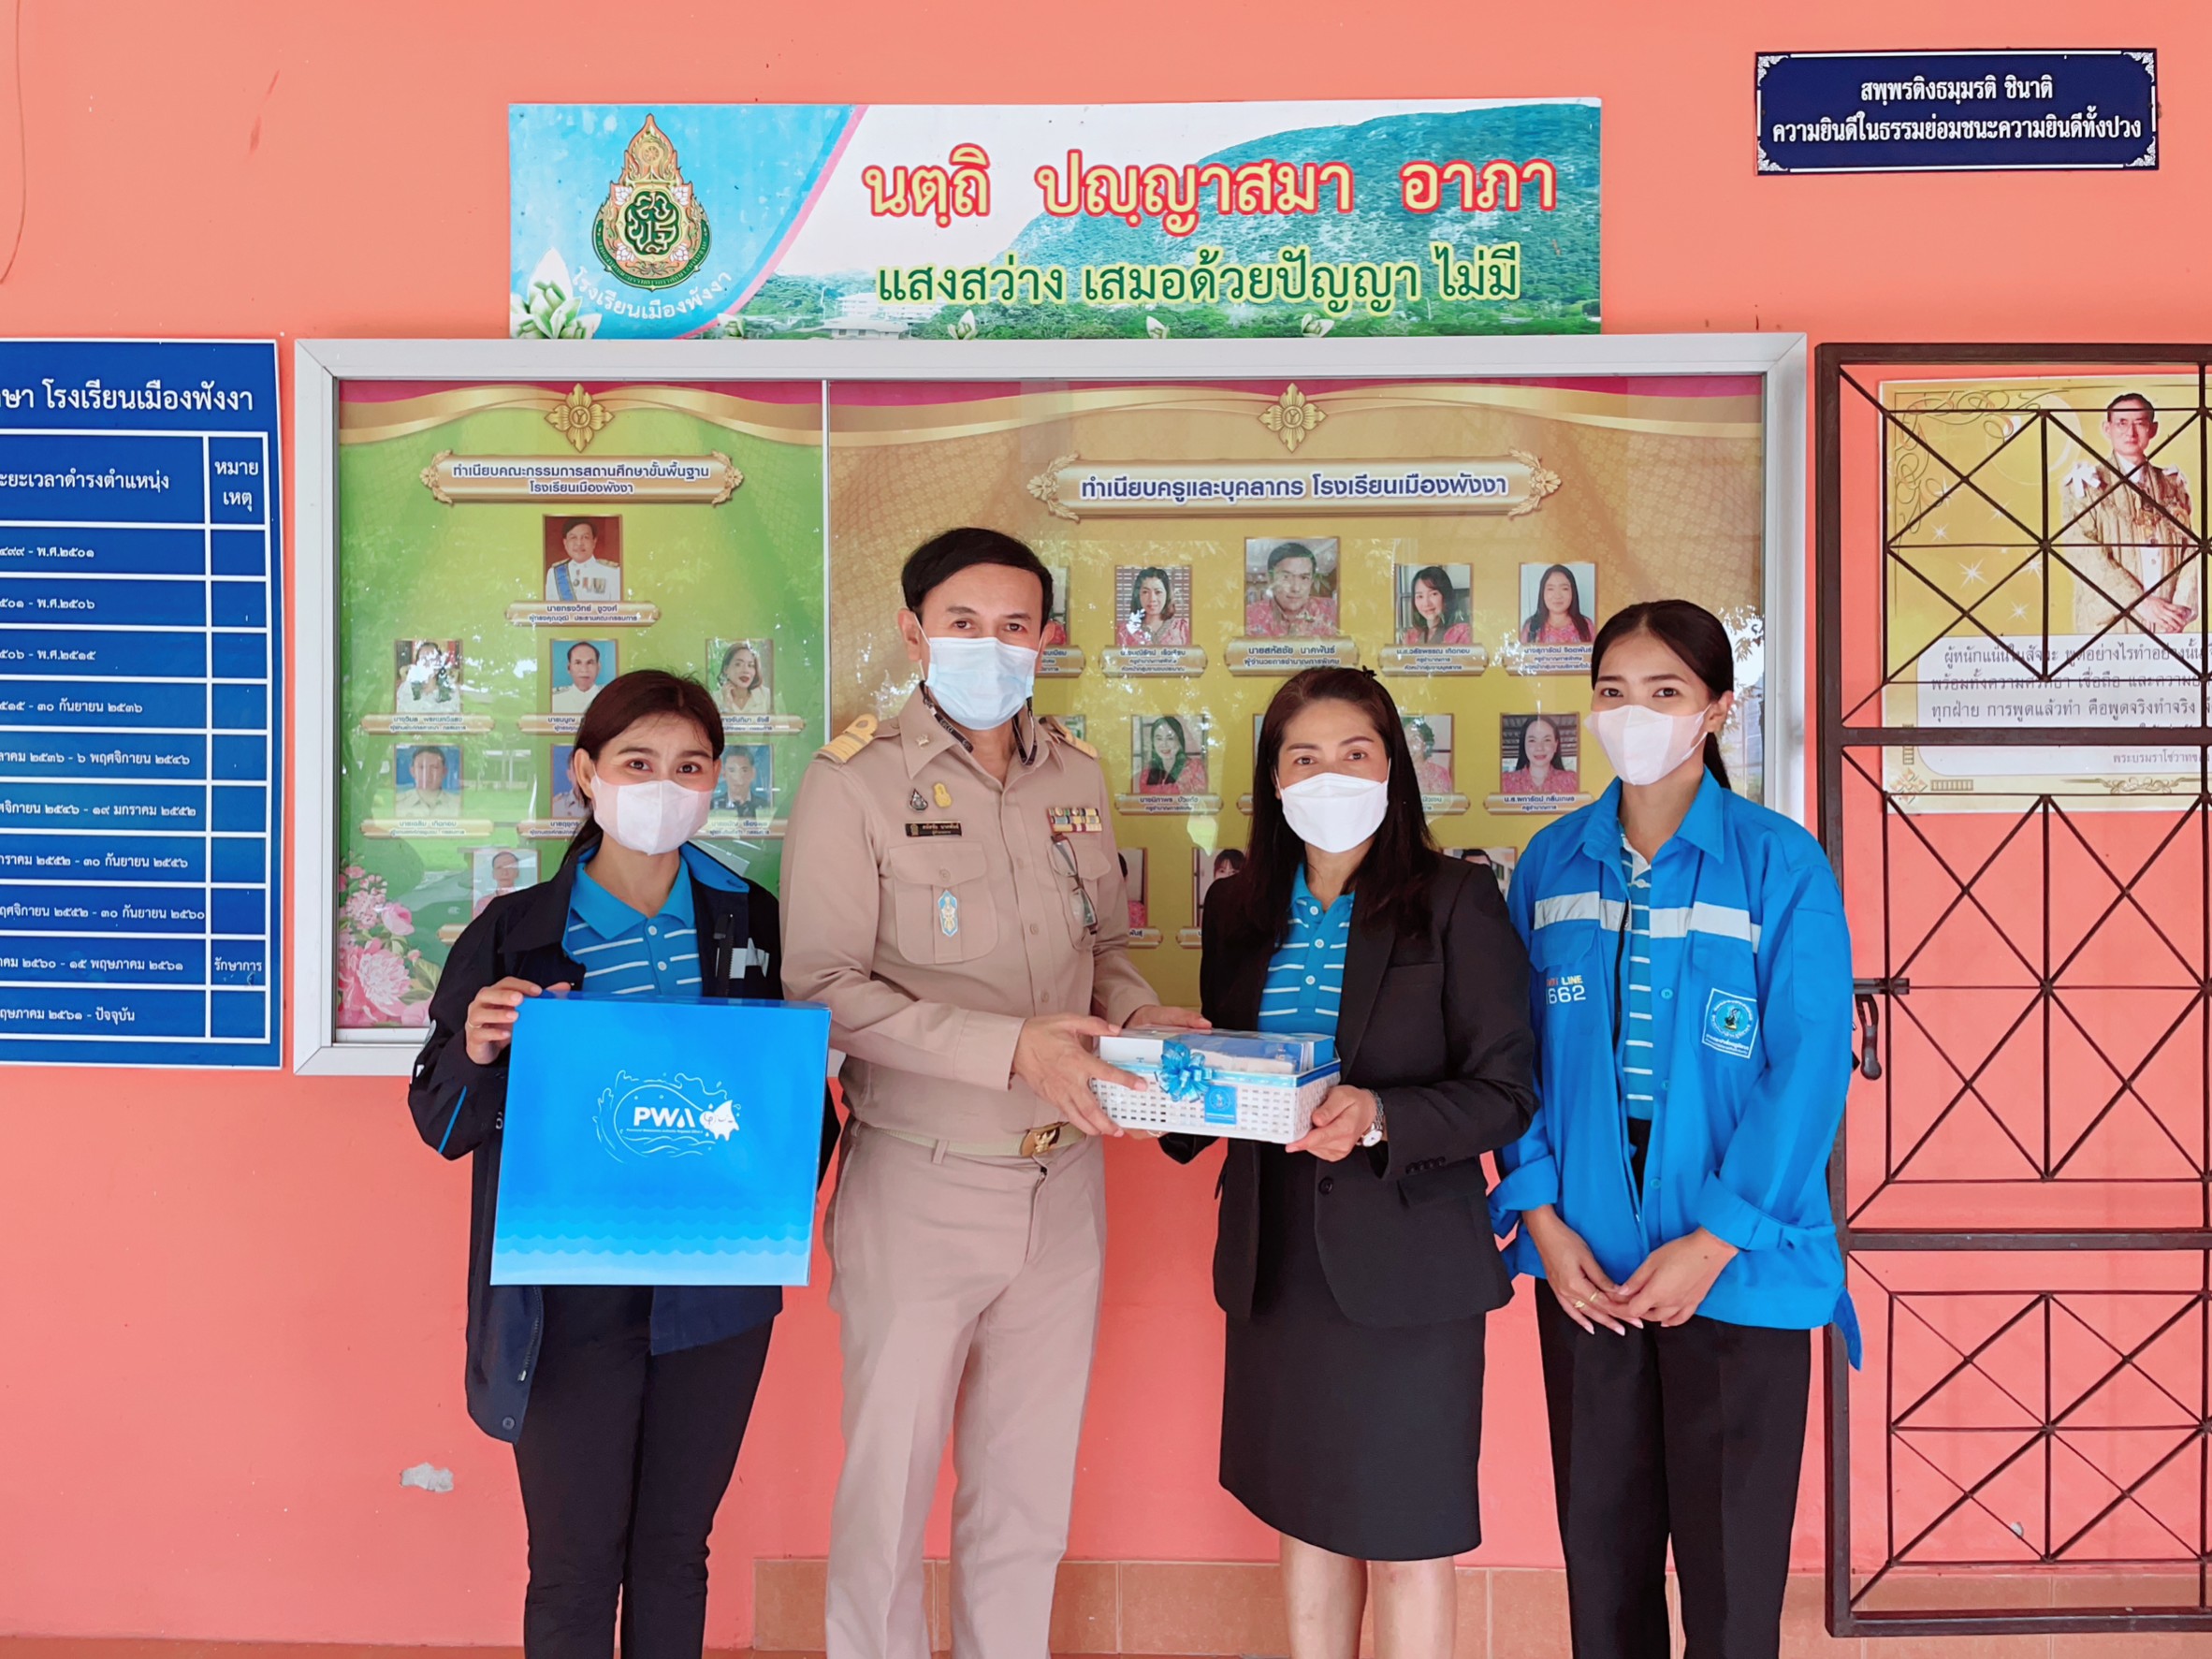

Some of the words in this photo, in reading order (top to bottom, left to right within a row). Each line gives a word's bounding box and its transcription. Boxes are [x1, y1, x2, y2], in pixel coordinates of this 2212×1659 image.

[2004, 74, 2053, 99] ชินาติ
[1772, 105, 2142, 142] ความยินดีในธรรมย่อมชนะความยินดีทั้งปวง
[1399, 158, 1556, 213] อาภา
[876, 255, 1064, 304] แสงสว่าง
[1082, 243, 1419, 317] เสมอด้วยปัญญา
[1431, 240, 1521, 301] ไม่มี
[572, 266, 732, 320] โรงเรียนเมืองพังงา
[0, 387, 34, 409] ษา
[42, 378, 253, 411] โรงเรียนเมืองพังงา
[214, 460, 259, 475] หมาย
[453, 461, 709, 481] ทำเนียบคณะกรรมการสถานศึกษาขั้นพื้นฐาน
[530, 480, 633, 494] โรงเรียนเมืองพังงา
[1081, 474, 1304, 504] ทำเนียบครูและบุคลากร
[1312, 472, 1507, 499] โรงเรียนเมืองพังงา
[223, 489, 253, 512] เหตุ
[59, 697, 104, 712] กันยายน
[1931, 701, 1979, 722] ทุกฝ่าย
[1987, 699, 2081, 721] การพูดแล้วทำ
[2088, 698, 2195, 720] คือพูดจริงทำจริง
[90, 749, 152, 766] พฤศจิกายน
[114, 805, 157, 816] มกราคม
[105, 852, 150, 867] กันยายน
[123, 904, 167, 919] กันยายน
[91, 959, 145, 971] พฤษภาคม
[214, 956, 262, 972] รักษาการ
[1561, 975, 1583, 986] LINE
[95, 1006, 135, 1026] ปัจจุบัน
[633, 1106, 696, 1128] PWA
